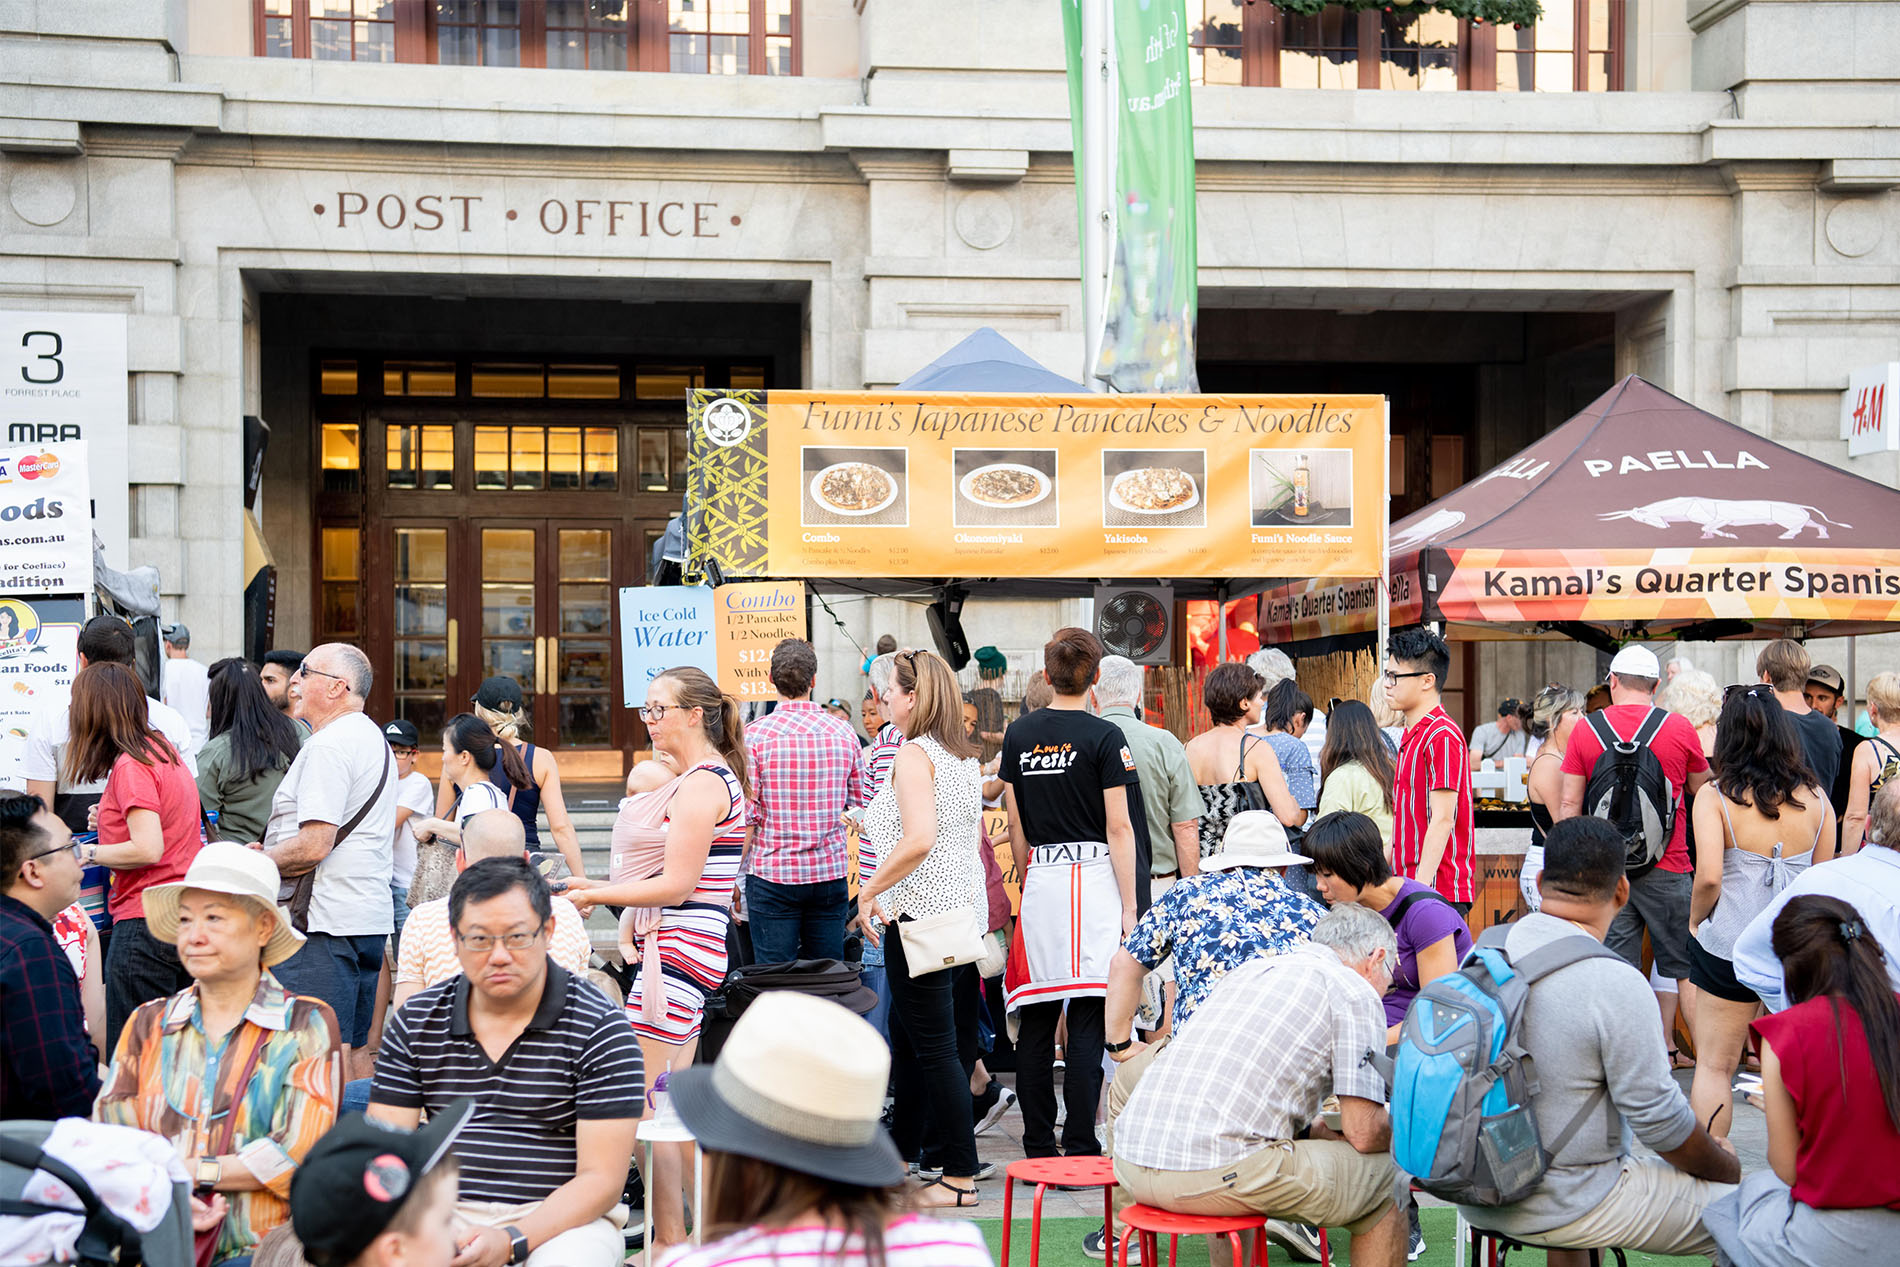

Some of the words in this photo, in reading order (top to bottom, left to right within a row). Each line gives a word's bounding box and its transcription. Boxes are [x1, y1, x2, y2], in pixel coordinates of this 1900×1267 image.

[337, 191, 483, 232] POST
[539, 199, 720, 238] OFFICE
[21, 330, 64, 384] 3
[5, 388, 48, 397] FORREST
[51, 389, 81, 398] PLACE
[1852, 383, 1885, 437] H&M
[802, 400, 902, 433] Fumi's
[908, 401, 1043, 441] Japanese
[1052, 402, 1189, 434] Pancakes
[1199, 404, 1225, 433] &
[1232, 402, 1353, 434] Noodles
[8, 423, 81, 443] MRA
[19, 461, 59, 473] MasterCard
[1583, 449, 1770, 478] PAELLA
[0, 497, 64, 522] ods
[802, 532, 840, 544] Combo
[954, 532, 1023, 545] Okonomiyaki
[1104, 533, 1148, 544] Yakisoba
[1251, 533, 1284, 544] Fumi's
[1286, 533, 1322, 544] Noodle
[1325, 533, 1353, 544] Sauce
[1484, 569, 1622, 597] Kamal's
[1635, 566, 1772, 595] Quarter
[1785, 566, 1900, 598] Spanis
[726, 589, 796, 610] Combo
[1301, 592, 1335, 618] Quarter
[1338, 581, 1376, 616] Spanish
[1389, 575, 1409, 603] ella
[639, 609, 660, 622] Ice
[663, 607, 697, 621] Cold
[727, 615, 744, 625] 1/2
[746, 614, 798, 624] Pancakes
[633, 626, 709, 648] Water
[730, 630, 747, 640] 1/2
[750, 628, 795, 639] Noodles
[24, 663, 68, 673] Foods
[734, 668, 761, 678] With
[1033, 743, 1059, 754] Love
[1060, 742, 1073, 753] it
[1019, 749, 1078, 772] Fresh!
